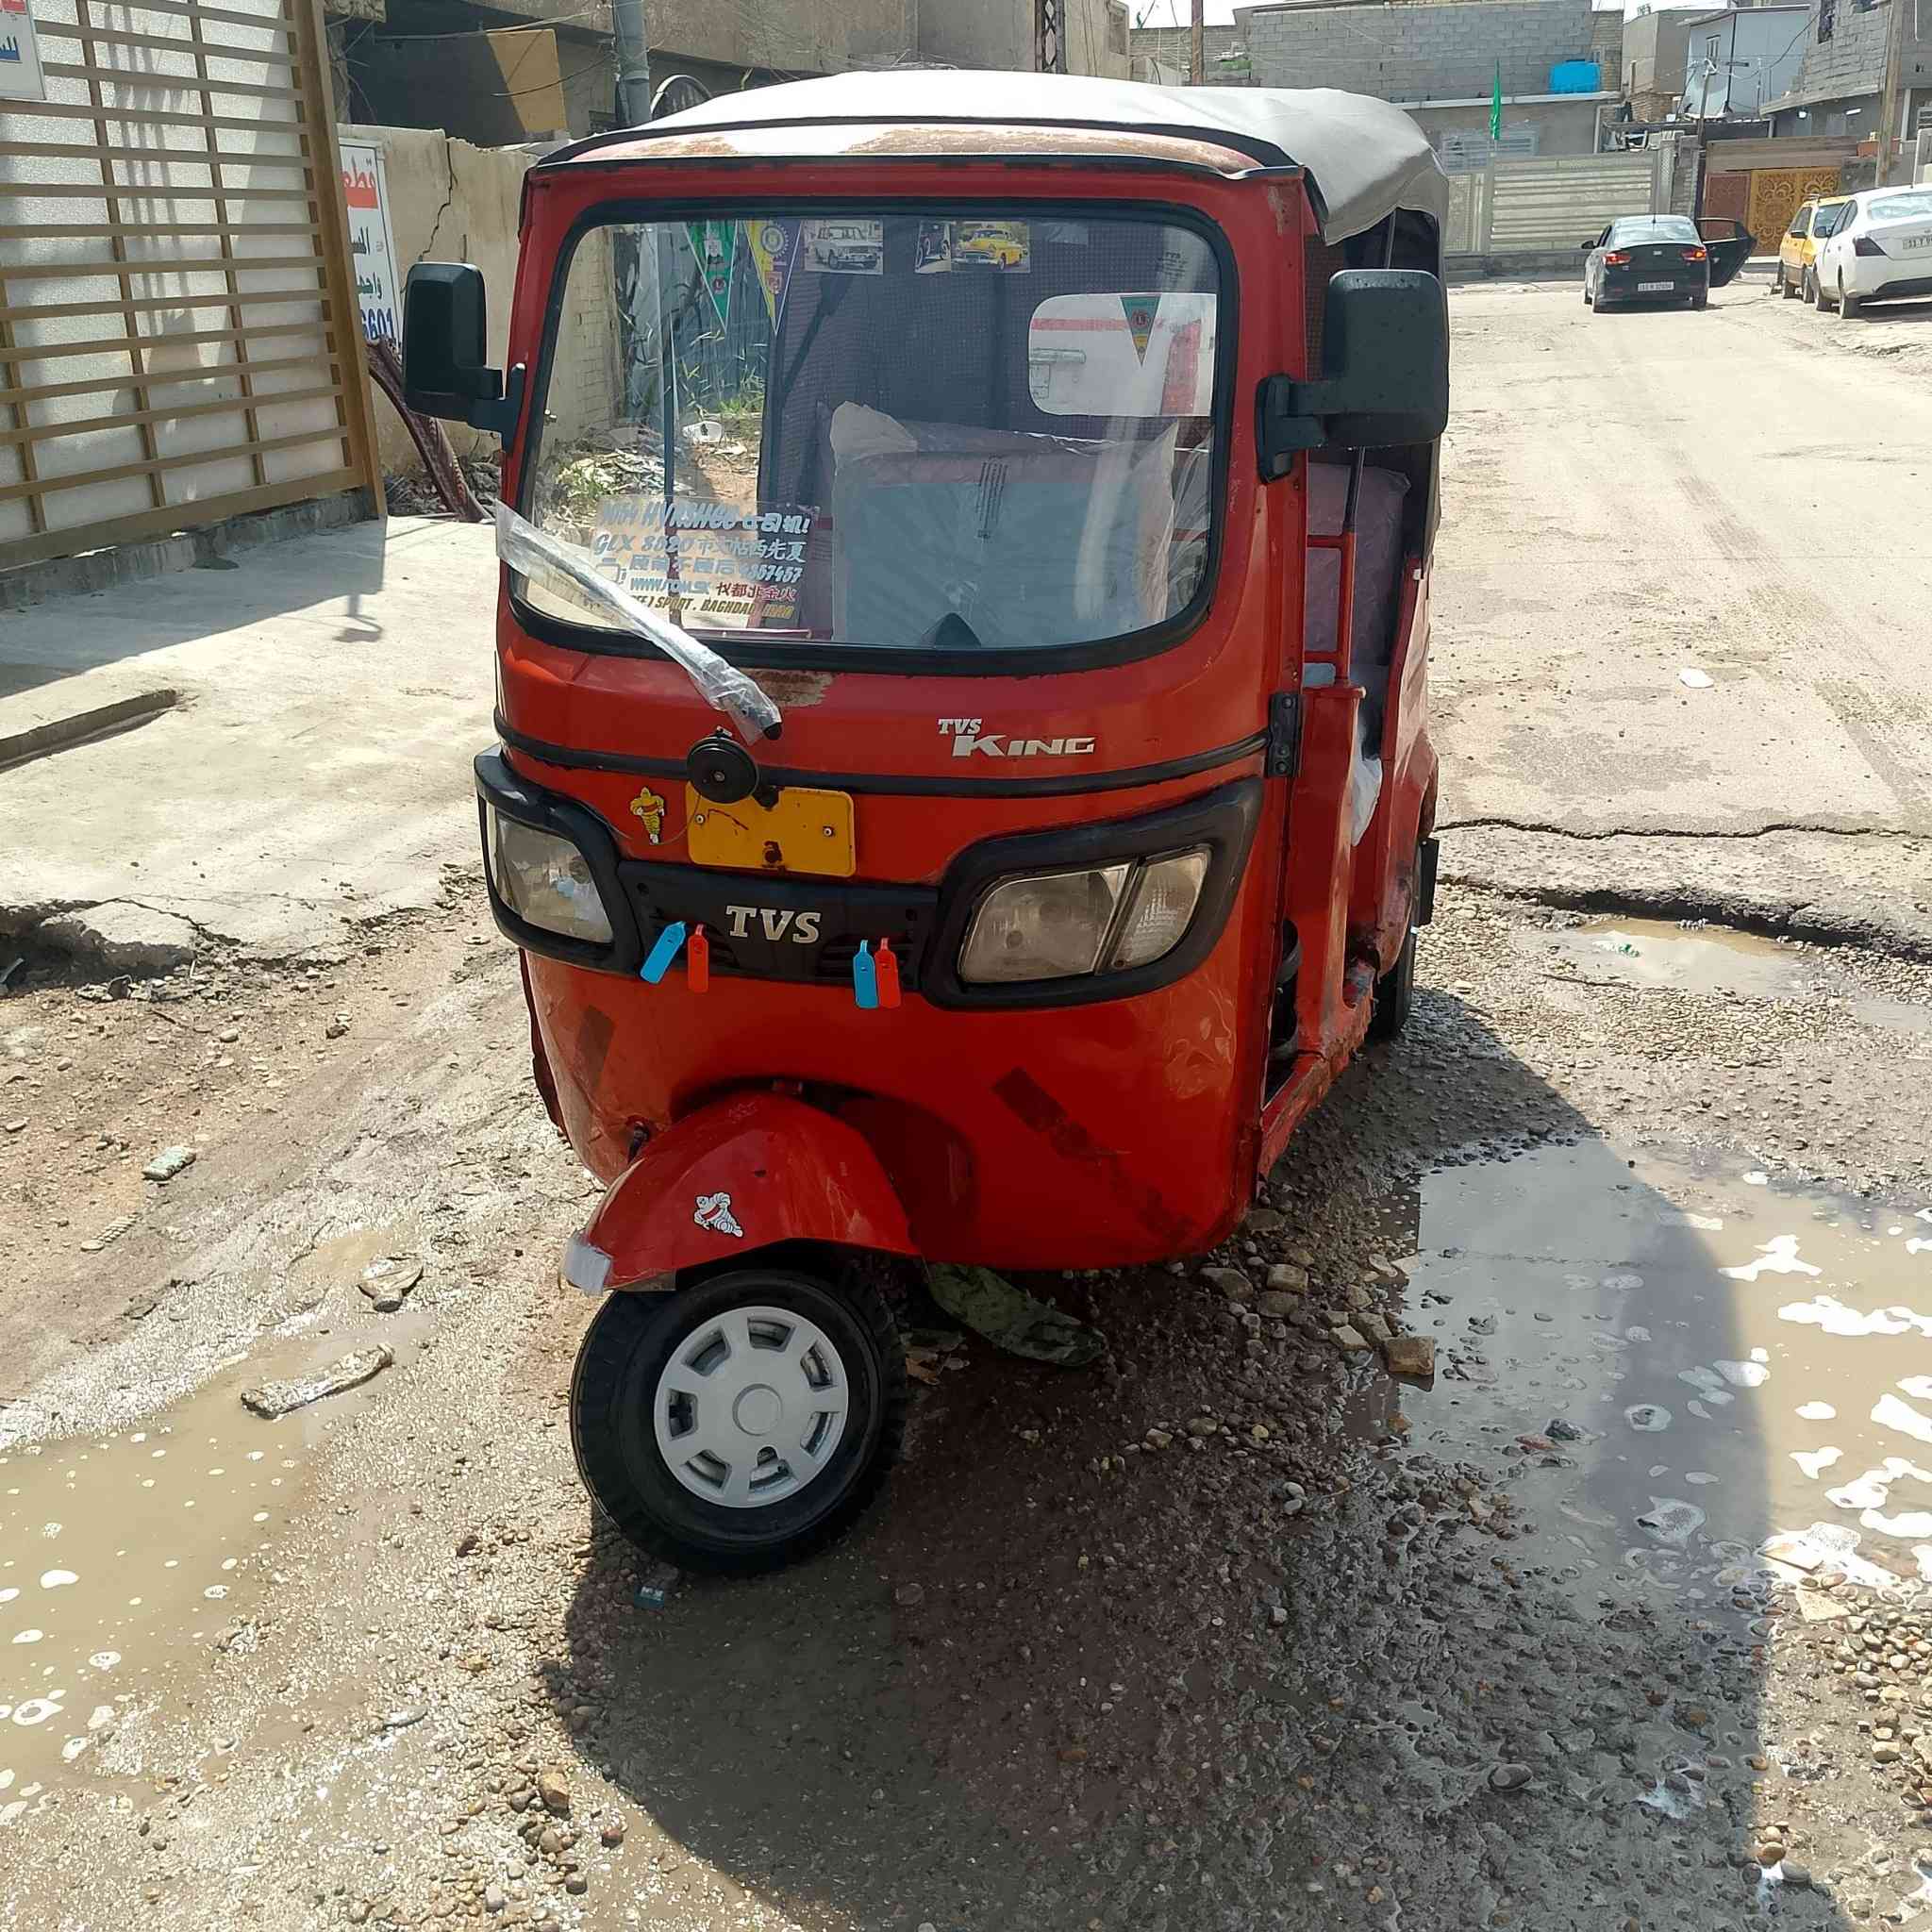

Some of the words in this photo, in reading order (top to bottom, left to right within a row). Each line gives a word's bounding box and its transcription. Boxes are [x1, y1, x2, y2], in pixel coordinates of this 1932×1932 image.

[938, 718, 982, 735] TVS
[952, 734, 1096, 758] KING
[725, 905, 822, 943] TVS
